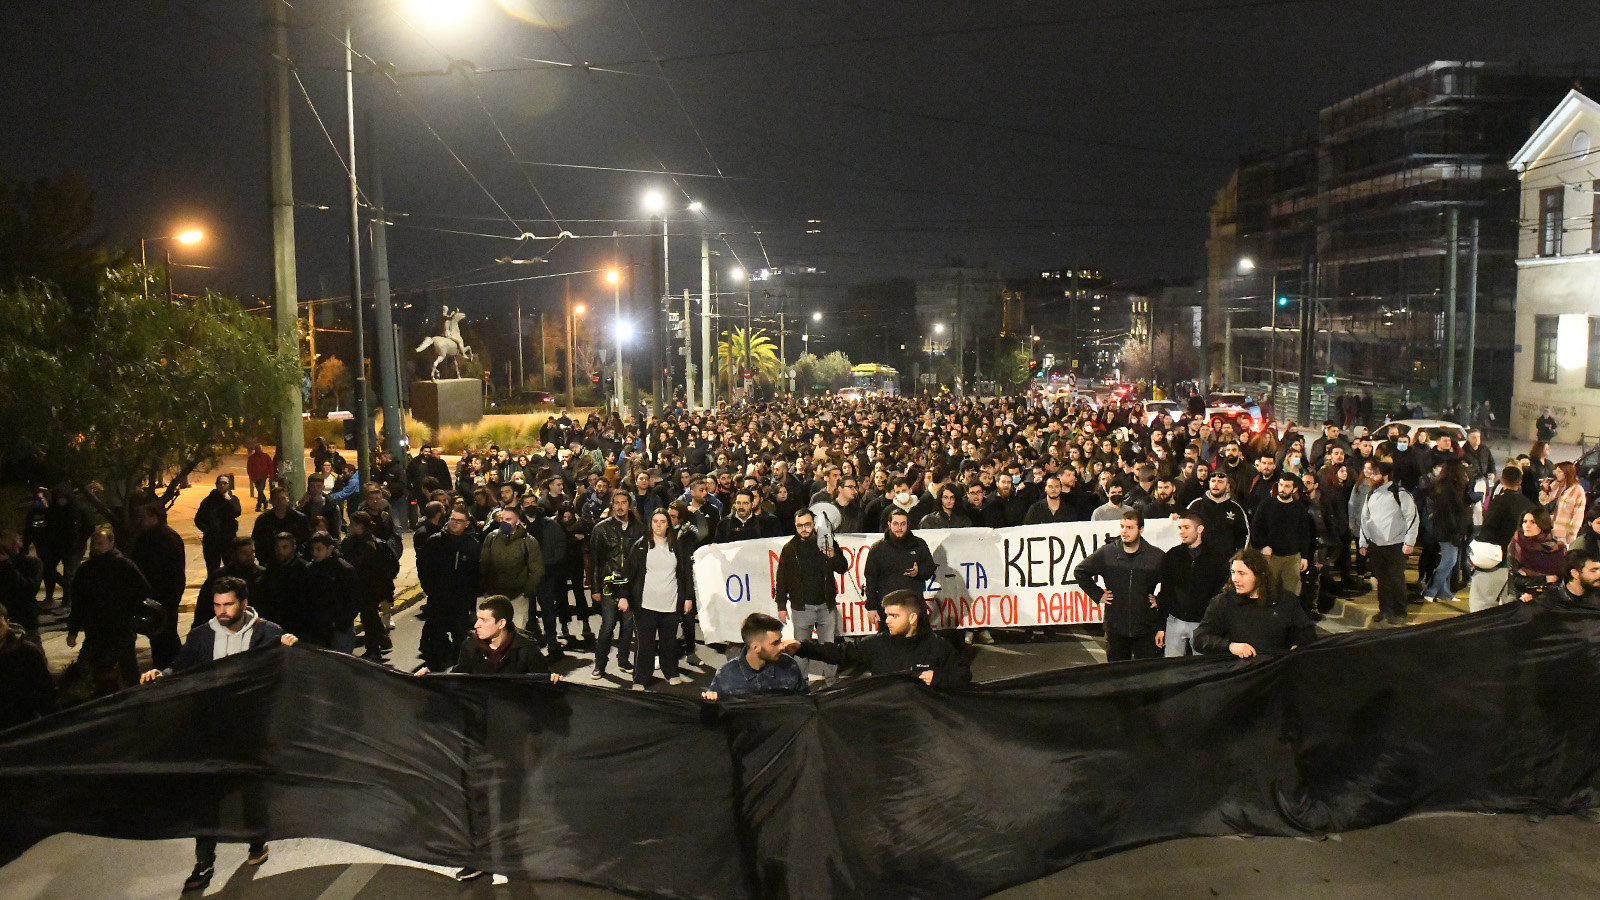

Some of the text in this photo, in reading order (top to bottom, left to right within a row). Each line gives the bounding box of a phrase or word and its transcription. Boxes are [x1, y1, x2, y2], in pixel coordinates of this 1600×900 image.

[725, 573, 751, 603] ΟΙ
[959, 561, 988, 589] ΤΑ
[1037, 589, 1108, 624] ΑΘΗΝΑ
